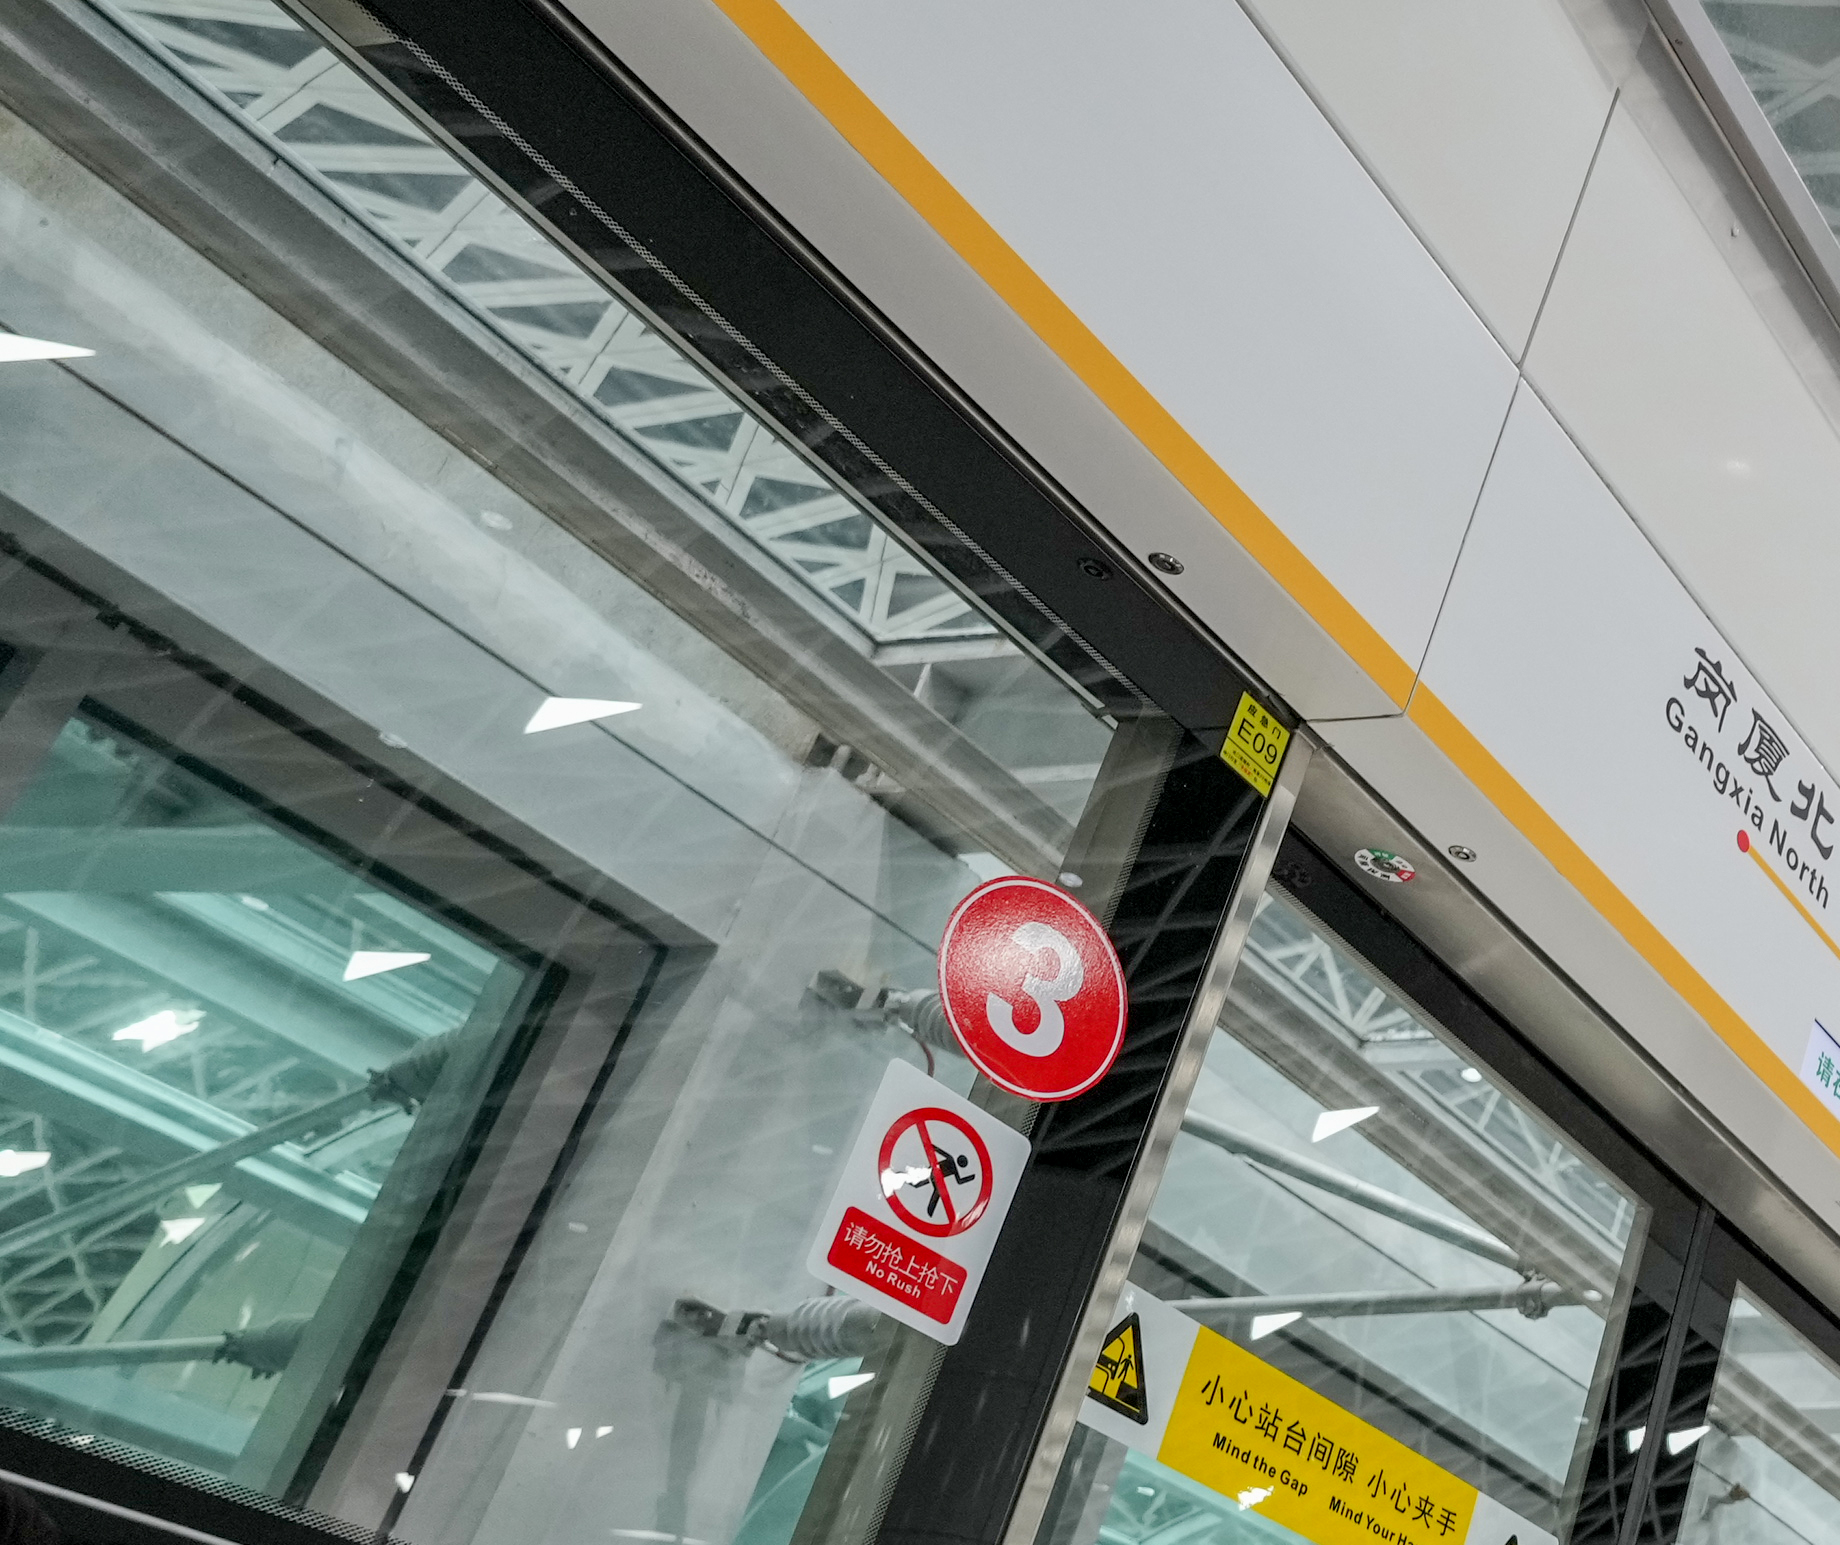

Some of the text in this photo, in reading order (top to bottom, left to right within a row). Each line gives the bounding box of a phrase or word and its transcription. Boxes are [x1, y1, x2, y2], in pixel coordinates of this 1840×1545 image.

[1237, 717, 1278, 765] E09
[1665, 696, 1830, 910] Gangxia North
[985, 921, 1085, 1058] 3
[844, 1221, 959, 1296] 请勿抢上抢下
[865, 1260, 921, 1299] No Rush
[1200, 1374, 1458, 1538] 小心站台间隙 小心夹手
[1212, 1431, 1309, 1496] Mind the Gap
[1328, 1495, 1363, 1526] Mind
[1365, 1513, 1396, 1542] Your
